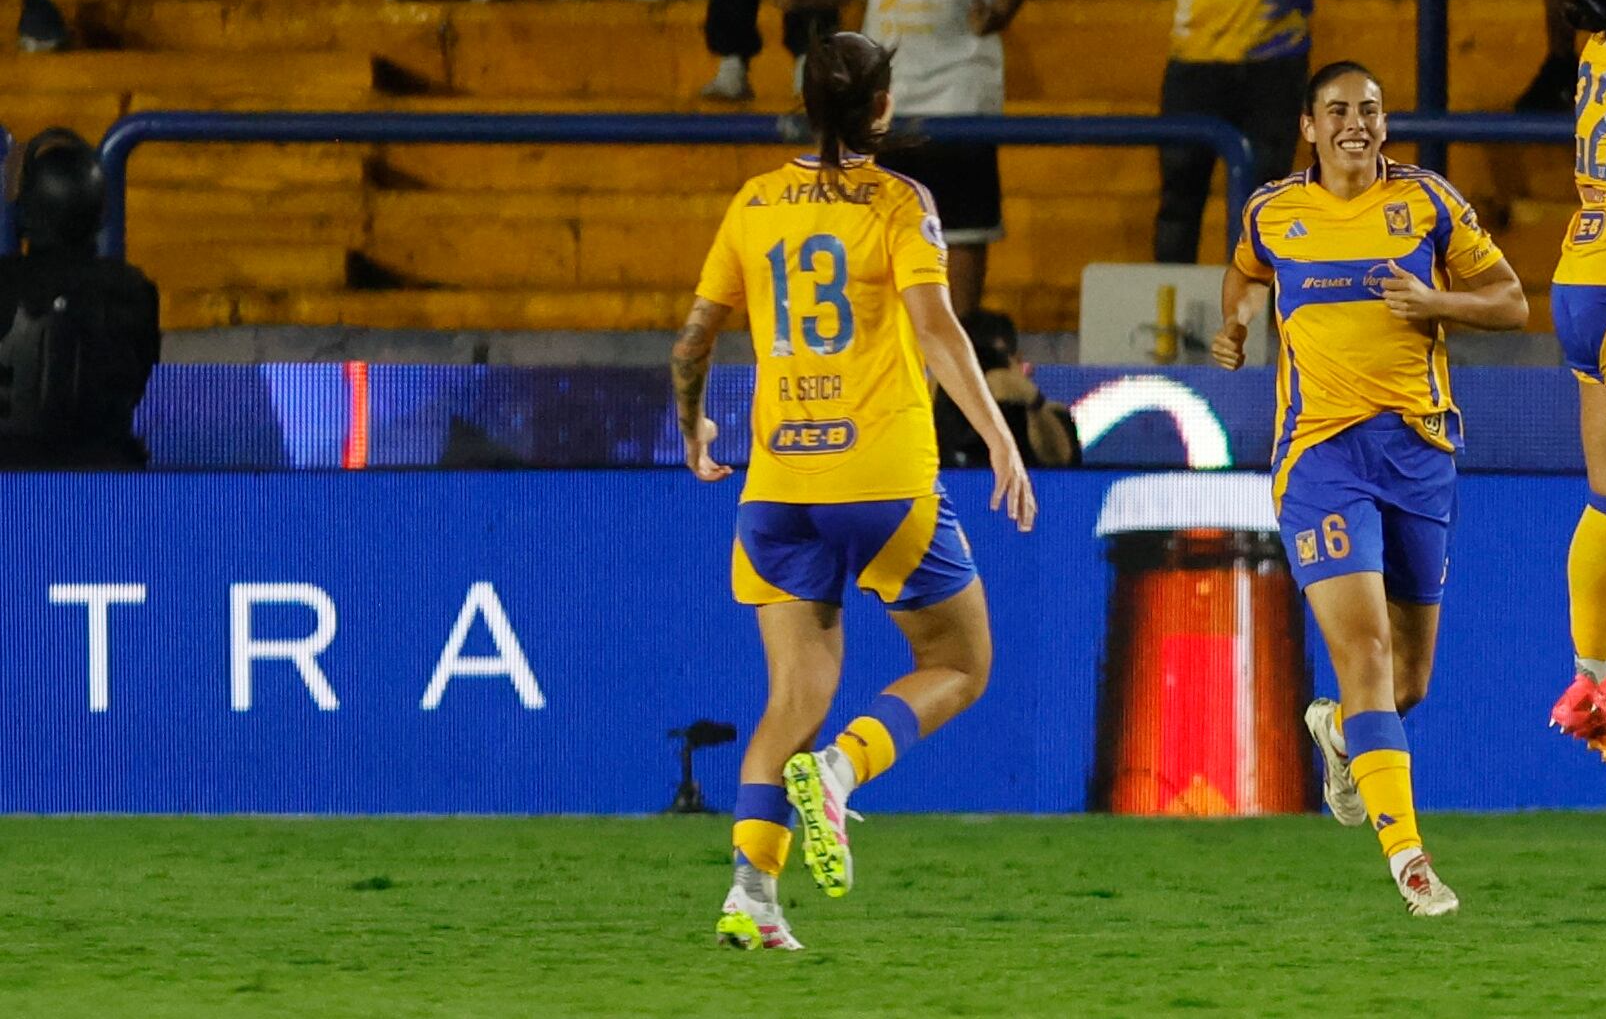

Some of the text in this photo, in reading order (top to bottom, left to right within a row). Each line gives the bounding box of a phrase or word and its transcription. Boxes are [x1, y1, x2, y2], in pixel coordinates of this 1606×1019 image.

[765, 234, 855, 357] 13
[1322, 514, 1352, 559] 6
[48, 581, 547, 712] TRA
